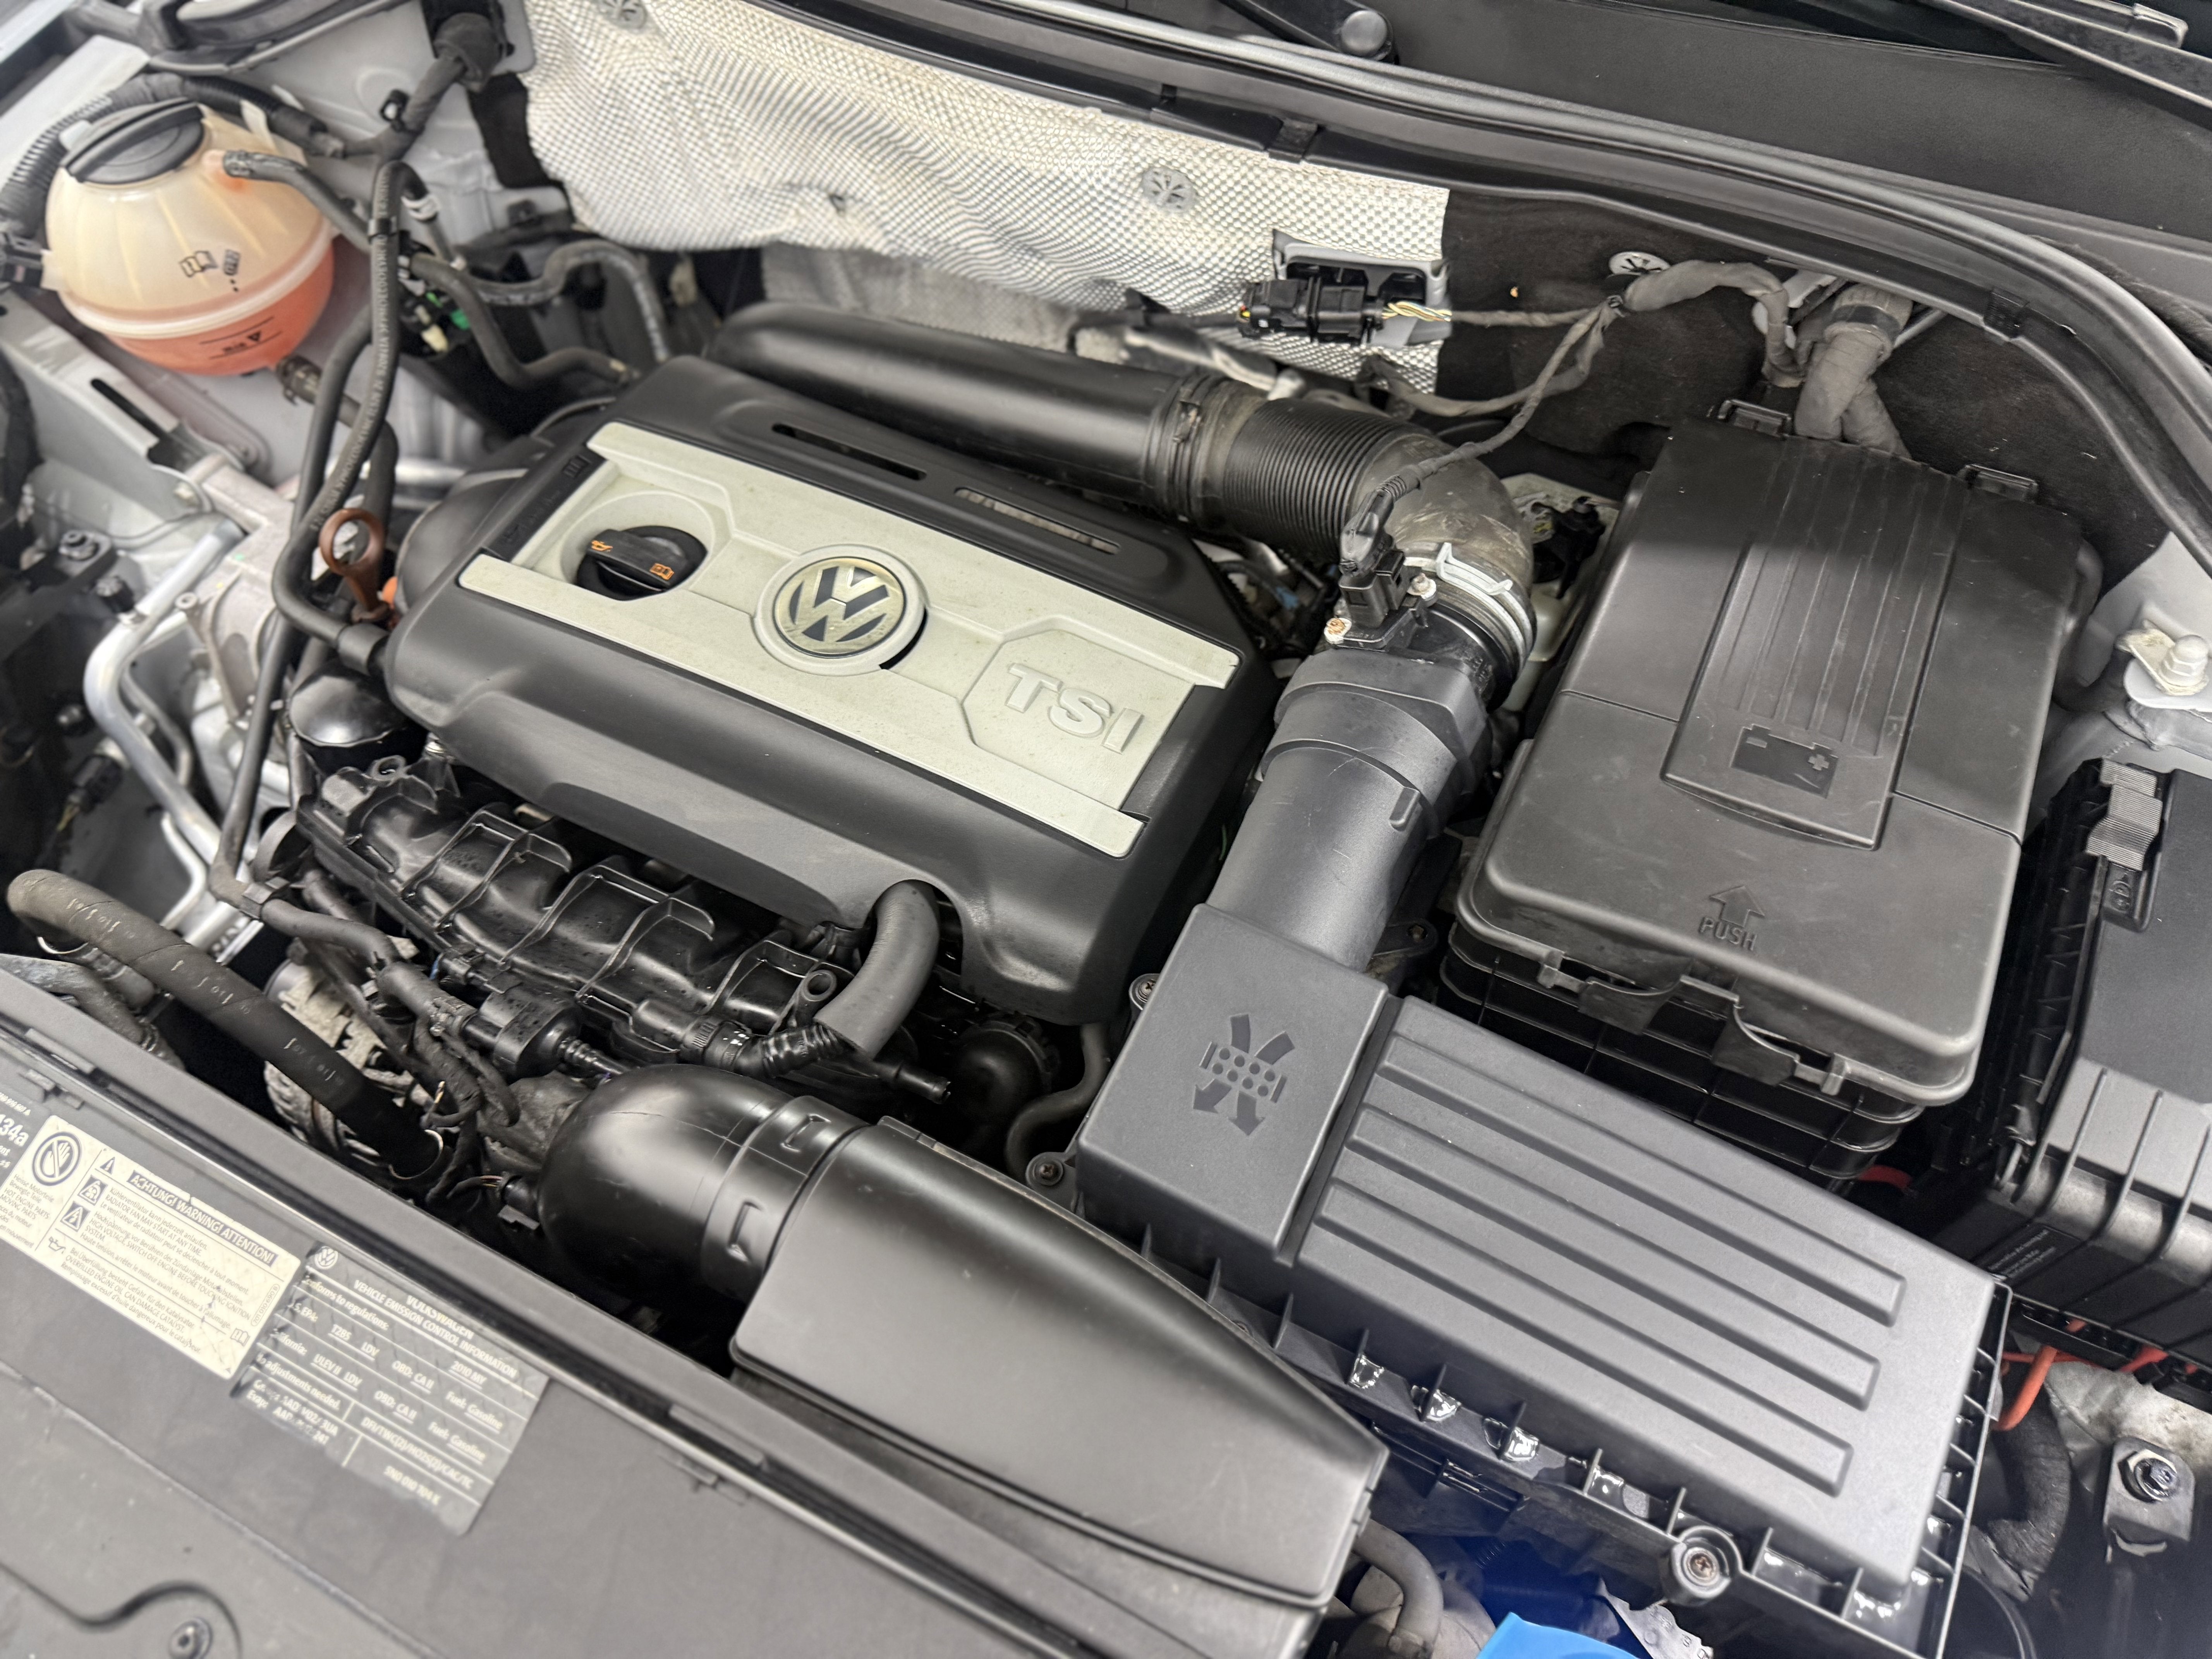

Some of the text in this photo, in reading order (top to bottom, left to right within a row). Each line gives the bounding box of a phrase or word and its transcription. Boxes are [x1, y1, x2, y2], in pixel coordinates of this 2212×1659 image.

[774, 556, 907, 658] VW
[1005, 663, 1145, 755] TSI
[1698, 917, 1757, 951] PUSH
[0, 1194, 37, 1219] MOVING PARTS
[4, 1188, 50, 1219] HOT ENGINE PARTS
[105, 1194, 131, 1213] RADIATOR
[130, 1209, 141, 1219] FAN
[140, 1216, 154, 1226] MAY
[153, 1223, 170, 1236] START
[175, 1237, 189, 1247] ANY
[130, 1175, 275, 1263] ACHTUNG! WARNING! ATTENTION!
[107, 1206, 134, 1224] ventilateur
[140, 1226, 164, 1243] radiateur
[162, 1240, 177, 1251] peut
[214, 1270, 226, 1281] tout
[225, 1278, 249, 1295] moment.
[131, 1235, 140, 1243] vor
[163, 1254, 173, 1262] der
[148, 1210, 161, 1222] kann
[159, 1218, 184, 1236] jederzeit
[184, 1233, 207, 1250] anlaufen.
[65, 1255, 95, 1276] OVERFILLED
[94, 1273, 115, 1288] ENGINE
[114, 1285, 123, 1295] OIL
[124, 1291, 137, 1302] CAN
[136, 1298, 161, 1317] DAMAGE
[80, 1232, 96, 1245] Haute
[138, 1269, 158, 1283] moteur
[157, 1280, 175, 1295] avant
[179, 1293, 200, 1309] toucher
[89, 1218, 104, 1230] HIGH
[126, 1241, 148, 1257] SWITCH
[147, 1254, 158, 1263] OFF
[157, 1259, 178, 1275] ENGINE
[177, 1271, 198, 1288] BEFORE
[225, 1301, 251, 1320] IGNITION
[108, 1271, 129, 1287] besteht
[128, 1284, 146, 1298] Gefahr
[155, 1301, 165, 1310] den
[335, 1295, 346, 1305] to
[406, 1295, 474, 1340] VOLKSWAGEN
[155, 1322, 169, 1333] pour
[354, 1280, 517, 1378] VEHICLE EMISSION CONTROL INFORMATION
[264, 1361, 312, 1393] adjustments
[361, 1342, 380, 1356] LDV
[414, 1373, 426, 1386] CA
[467, 1404, 503, 1430] Gasoline
[451, 1361, 472, 1377] 2010
[313, 1354, 336, 1370] ULEV
[343, 1372, 362, 1387] LDV
[396, 1404, 409, 1416] CA
[450, 1435, 486, 1462] Gasoline
